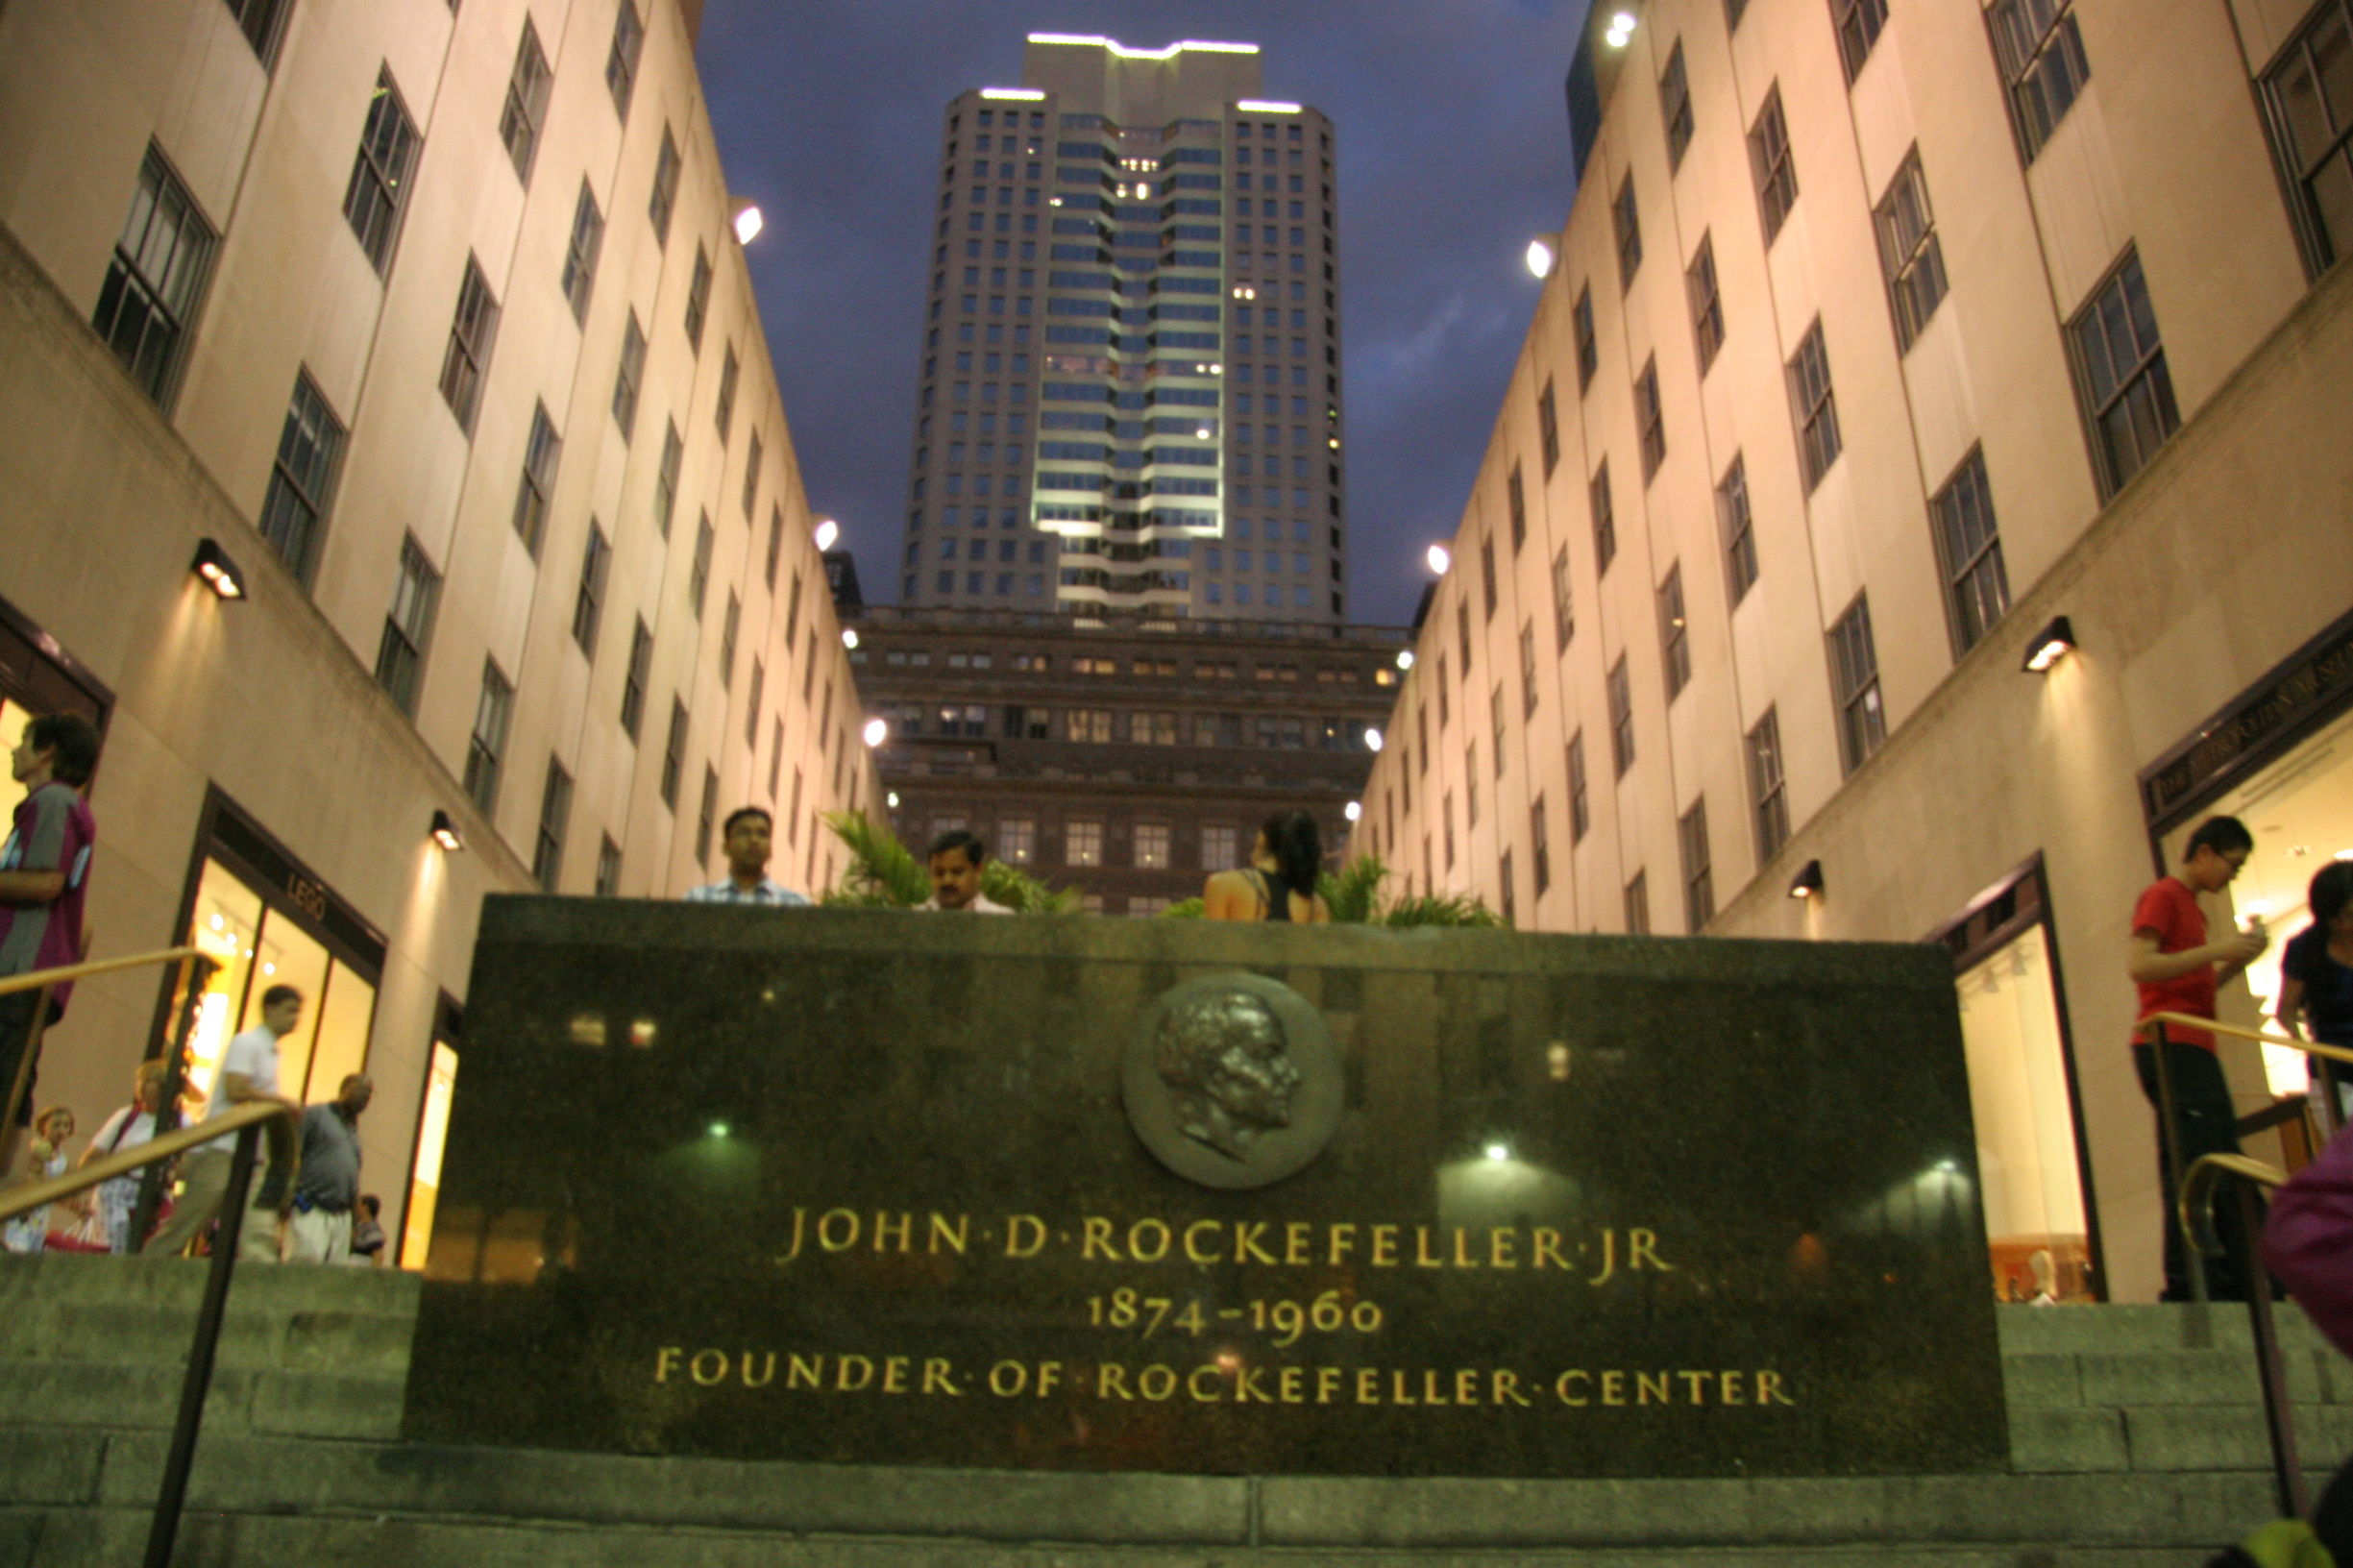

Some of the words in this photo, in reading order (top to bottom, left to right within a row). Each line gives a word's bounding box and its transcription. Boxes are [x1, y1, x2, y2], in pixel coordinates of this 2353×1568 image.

[287, 872, 327, 921] LEGO
[777, 1208, 969, 1266] JOHN
[1081, 1215, 1574, 1272] ROCKEFELLER
[654, 1346, 962, 1397] FOUNDER
[987, 1359, 1063, 1399] OF
[1097, 1362, 1532, 1408] ROCKEFELLER
[1555, 1368, 1796, 1408] CENTER
